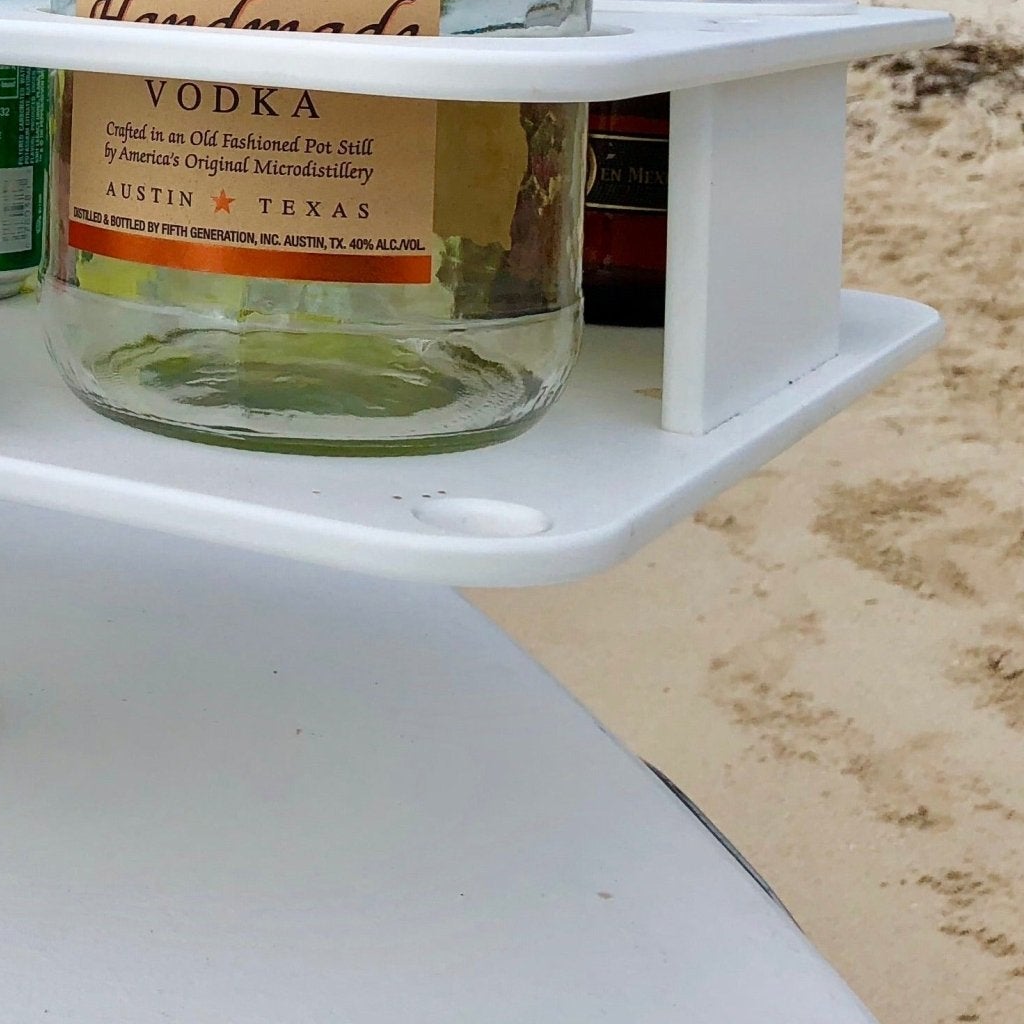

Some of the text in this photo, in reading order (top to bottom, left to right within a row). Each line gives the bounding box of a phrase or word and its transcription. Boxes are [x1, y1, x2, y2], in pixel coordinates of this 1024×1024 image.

[144, 79, 320, 119] VODKA
[106, 121, 374, 156] Crafted in an Old Fashioned Pot Still
[104, 142, 374, 185] by America's Original Microdistillery
[106, 181, 369, 219] AUSTIN TEXAS
[74, 206, 102, 224] DISTILLED
[103, 214, 109, 225] &
[110, 215, 145, 231] BOTTLED
[148, 222, 160, 233] BY
[162, 224, 188, 237] FIFTH
[190, 227, 257, 245] GENERATION,
[260, 233, 281, 245] INC.
[284, 234, 327, 250] AUSTIN,
[329, 237, 346, 249] TX.
[349, 238, 374, 250] 40%
